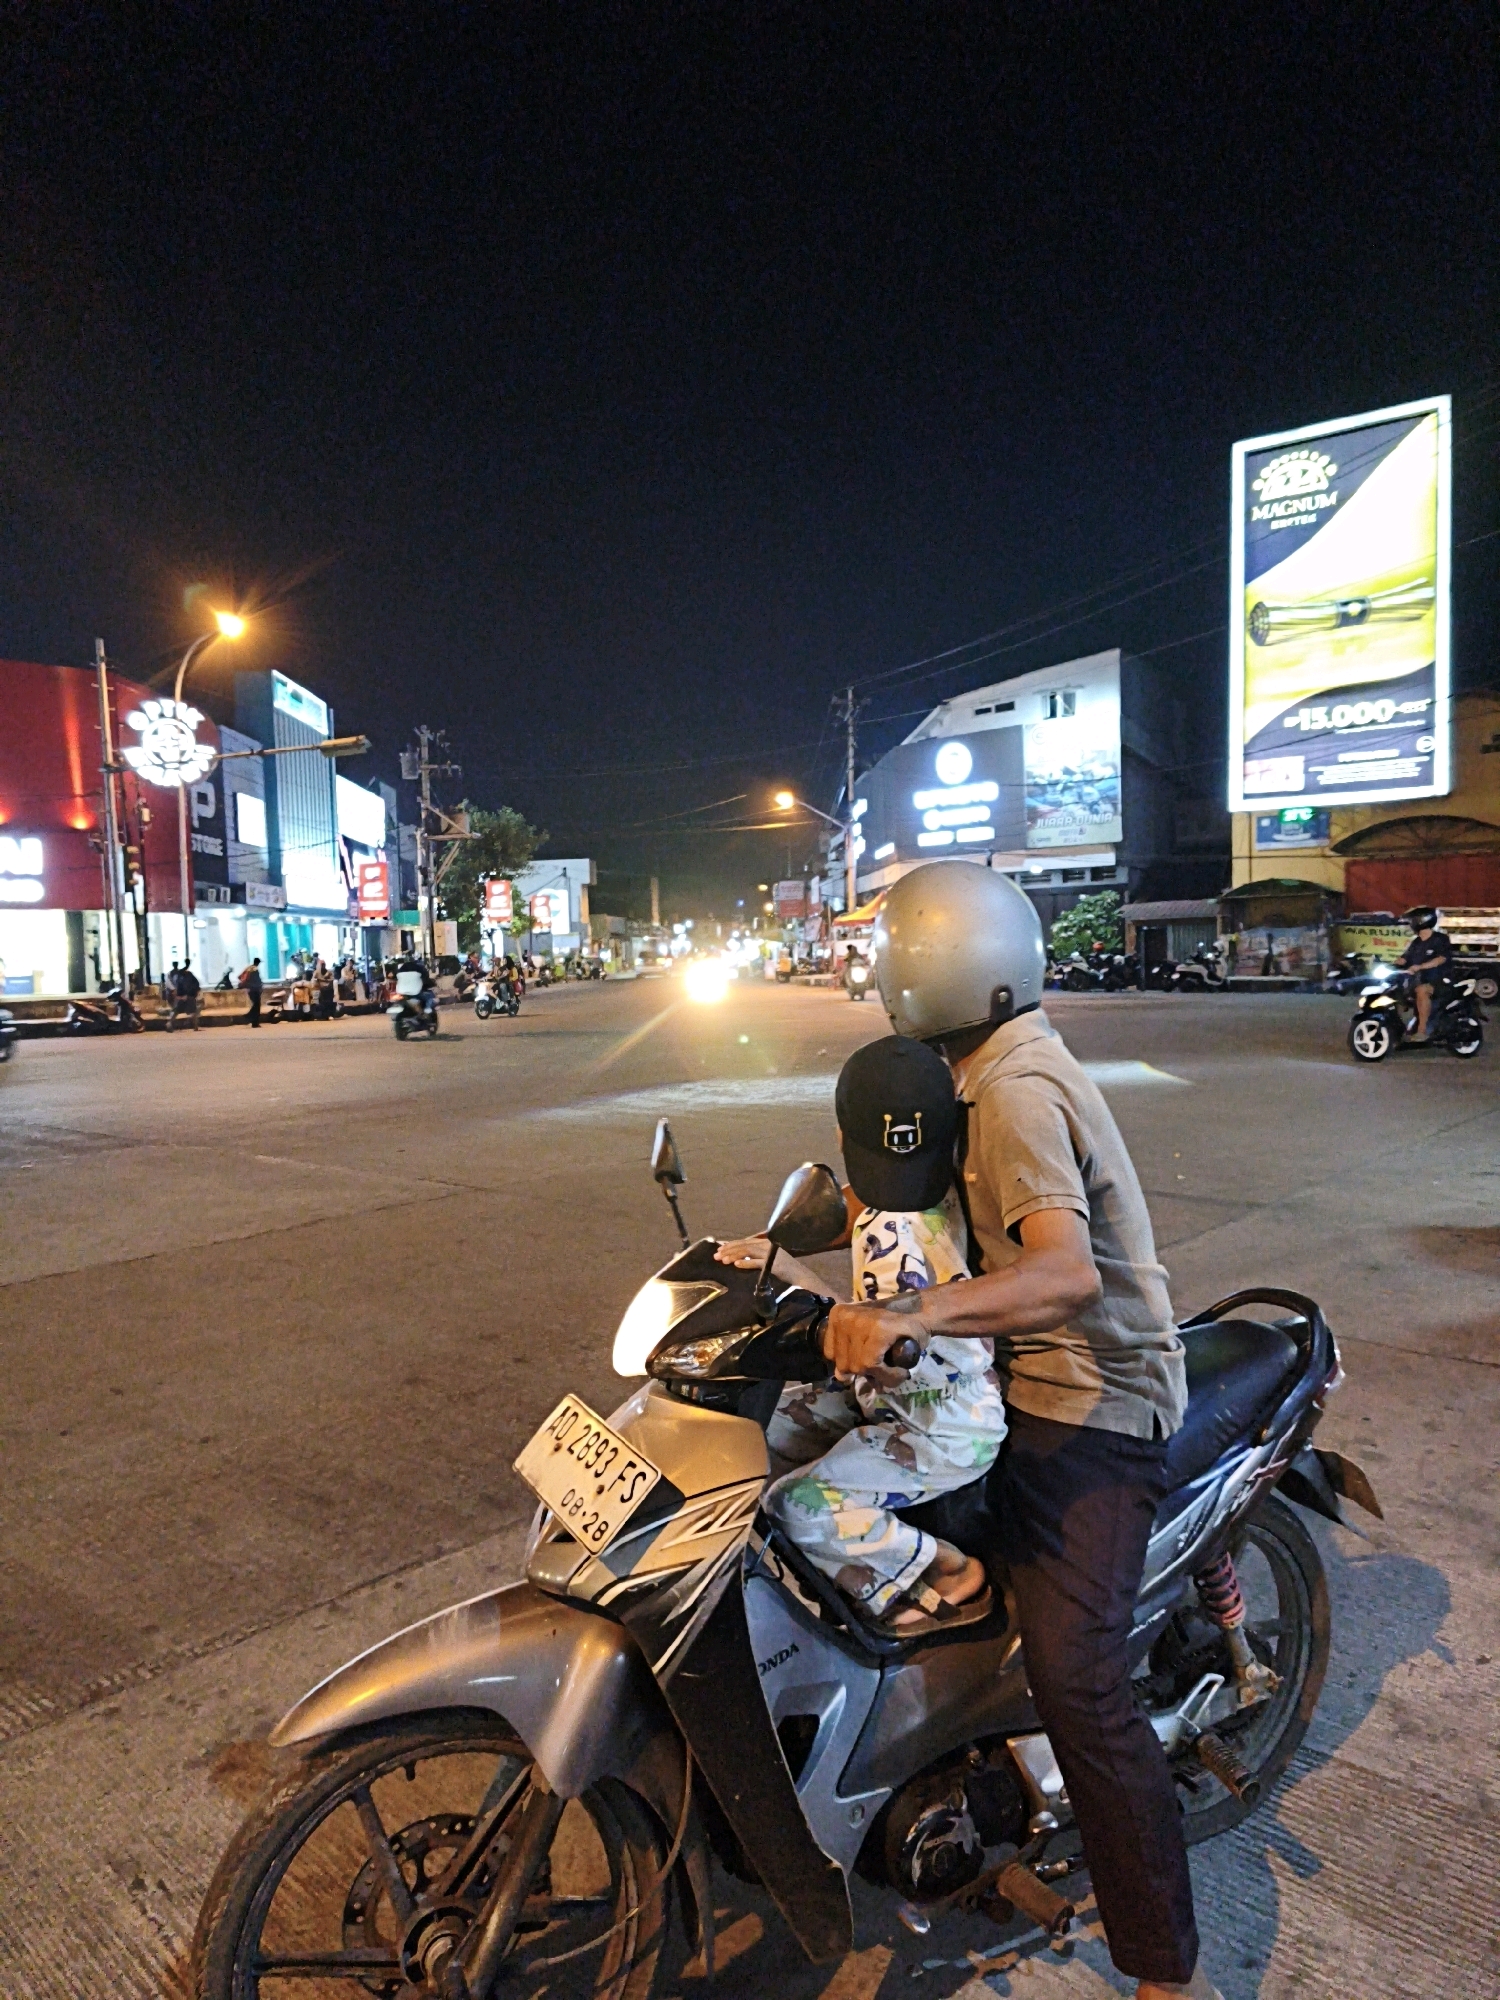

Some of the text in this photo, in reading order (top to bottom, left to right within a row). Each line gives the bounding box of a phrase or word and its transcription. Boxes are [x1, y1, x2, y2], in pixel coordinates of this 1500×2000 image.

[1251, 491, 1338, 521] MAGNUM
[1299, 699, 1396, 731] 15.000
[1034, 812, 1113, 829] JUARA DUNIA
[567, 1424, 619, 1479] 2893
[607, 1461, 647, 1503] FS
